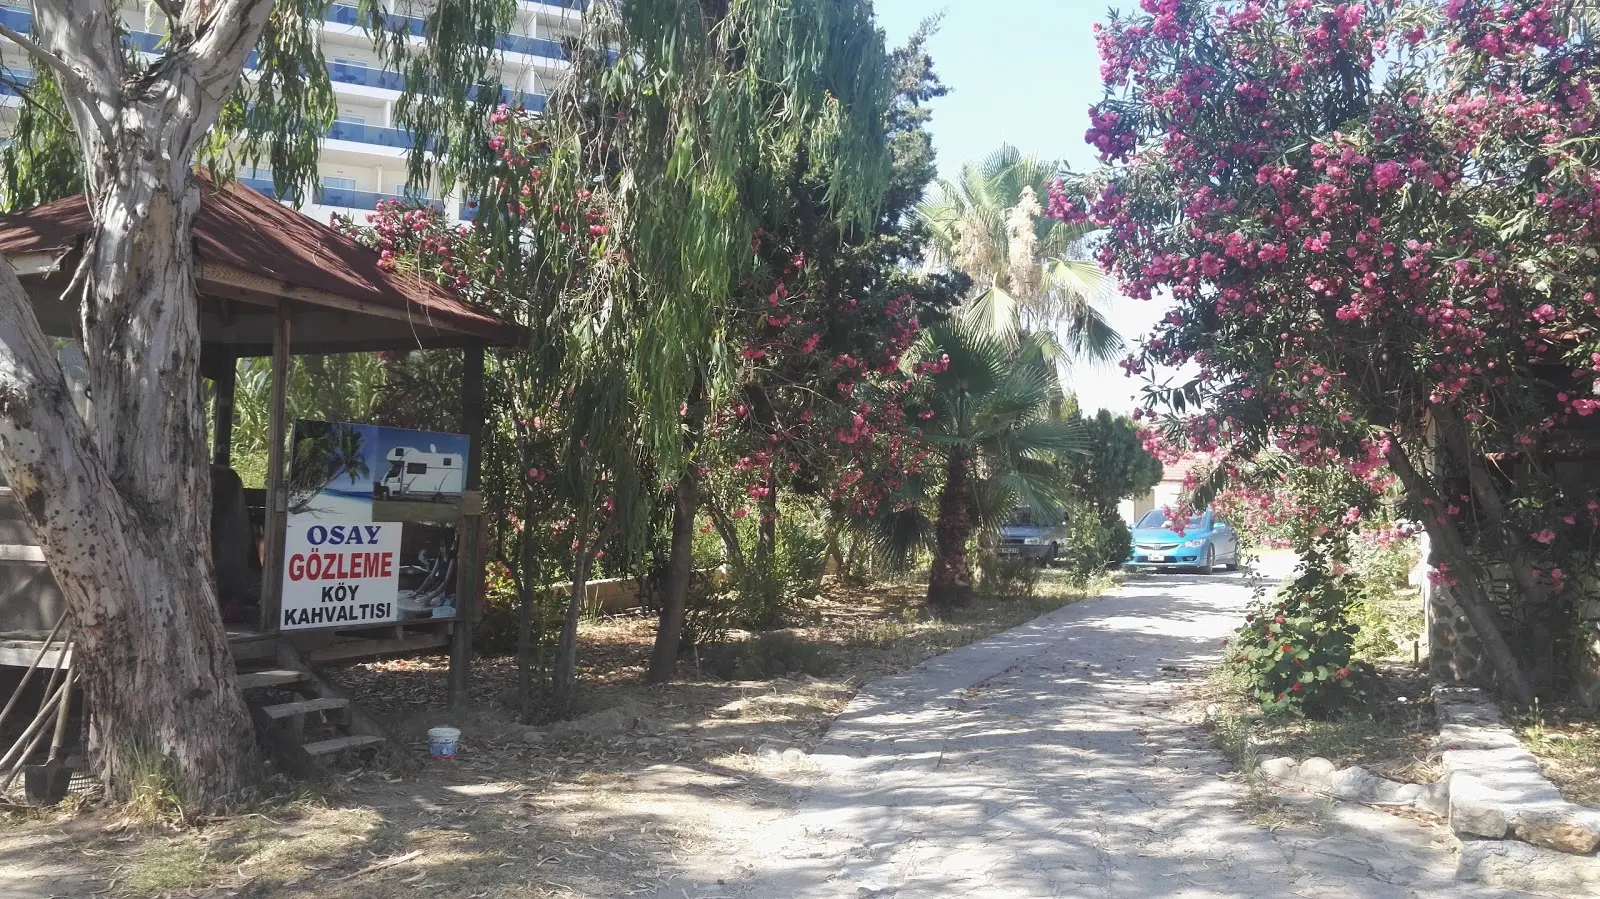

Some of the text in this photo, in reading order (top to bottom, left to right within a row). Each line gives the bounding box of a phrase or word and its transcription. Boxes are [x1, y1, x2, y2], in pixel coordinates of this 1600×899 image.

[307, 525, 381, 545] OSAY
[289, 548, 393, 581] GÖZLEME
[321, 582, 359, 602] KÖY
[284, 603, 391, 626] KAHVALTISI
